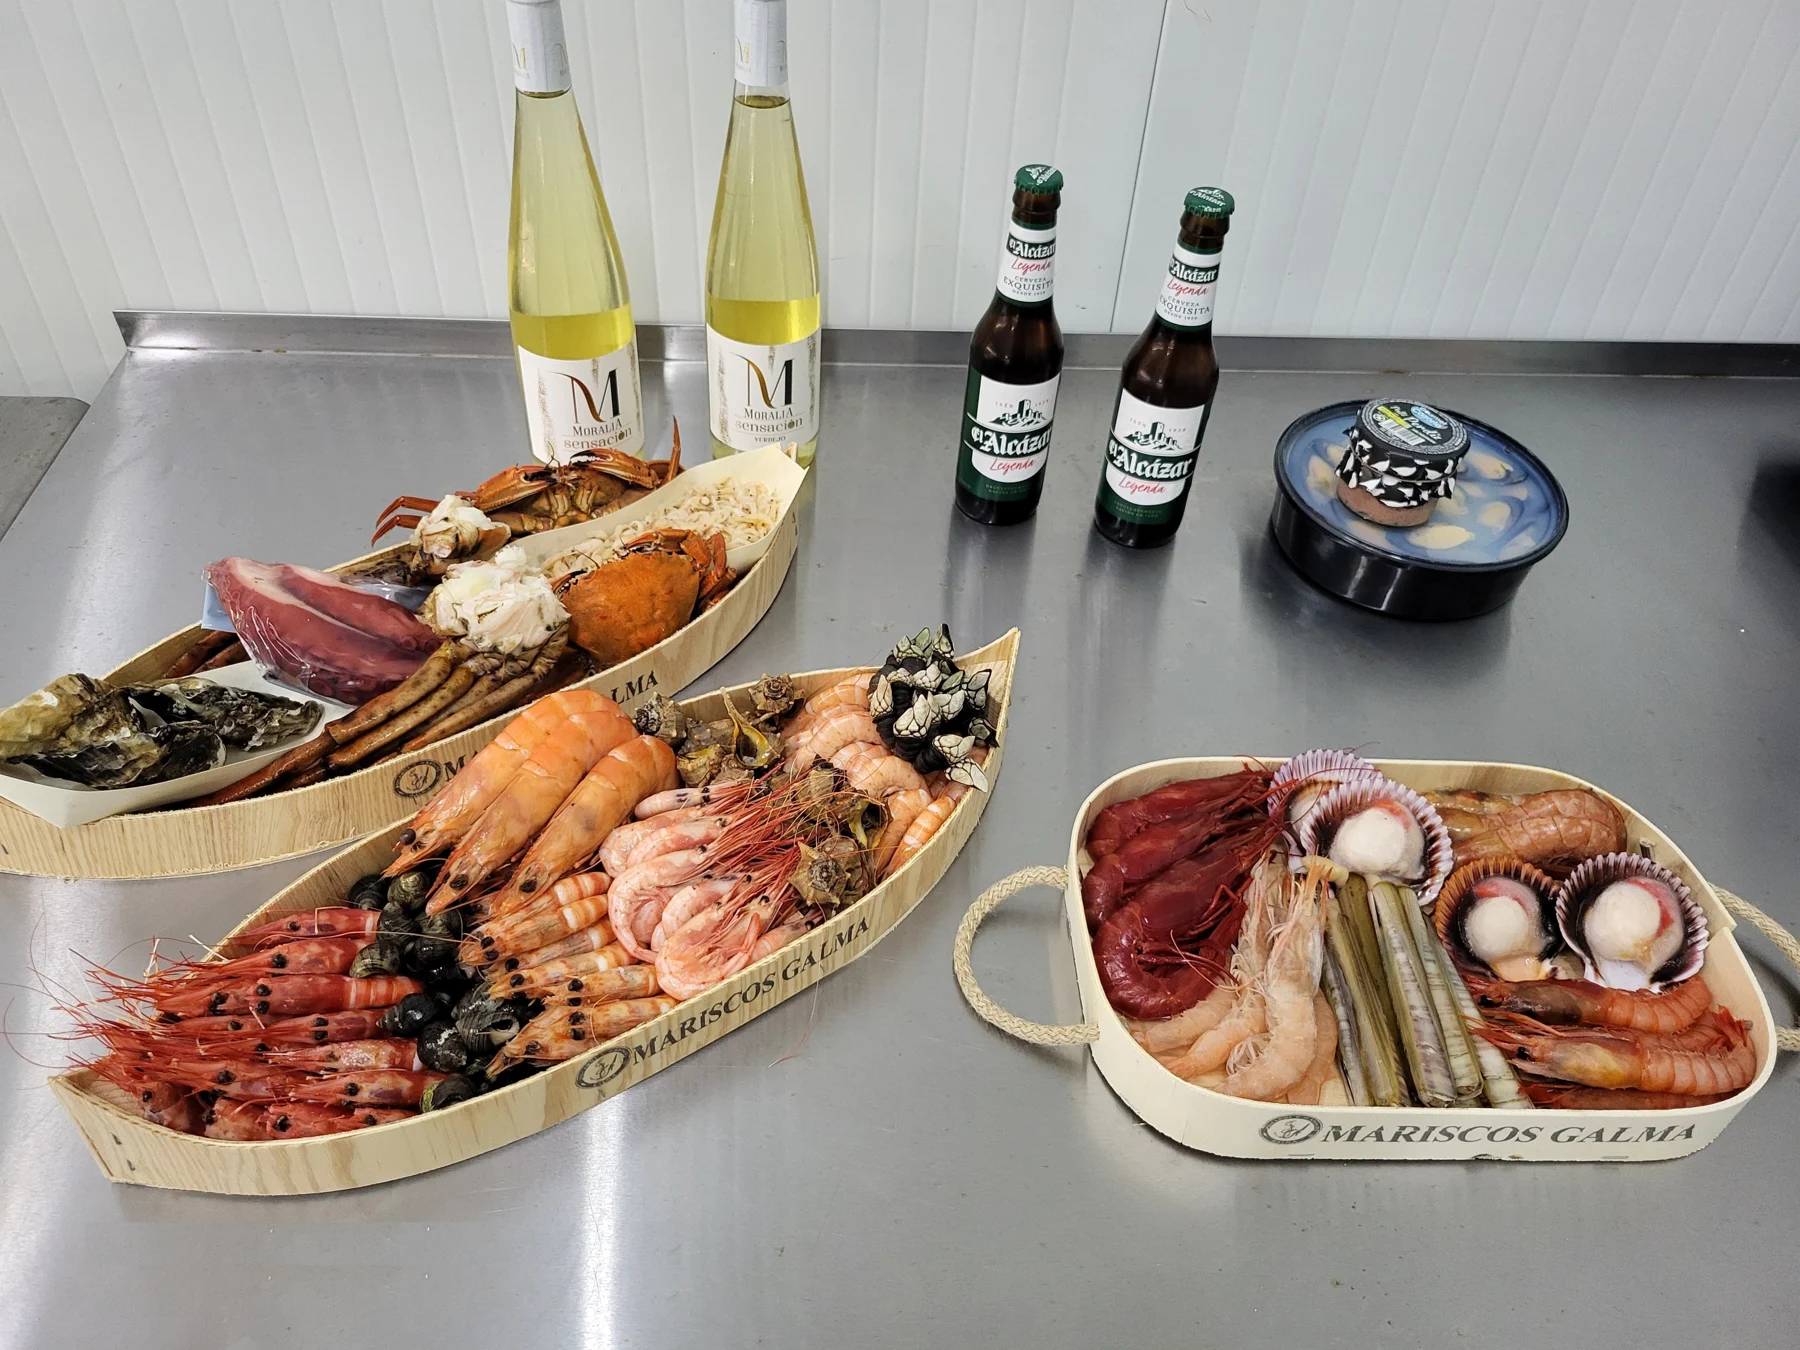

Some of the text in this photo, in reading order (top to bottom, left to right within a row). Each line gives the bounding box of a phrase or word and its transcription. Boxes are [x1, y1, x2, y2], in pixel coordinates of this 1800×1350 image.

[1011, 256, 1052, 276] Legenda
[1014, 275, 1047, 283] CERVEZA
[1167, 276, 1208, 297] Legenda
[1167, 295, 1200, 307] CERVEZA
[744, 407, 794, 420] MORALIA
[572, 418, 623, 437] MORALIA
[989, 458, 1037, 475] Legenda
[1118, 474, 1167, 495] Legenda
[610, 669, 659, 705] LMA
[631, 915, 869, 1067] MARISCOS GALMA
[1320, 1124, 1545, 1143] MARISCOS
[1549, 1122, 1697, 1143] GALMA
